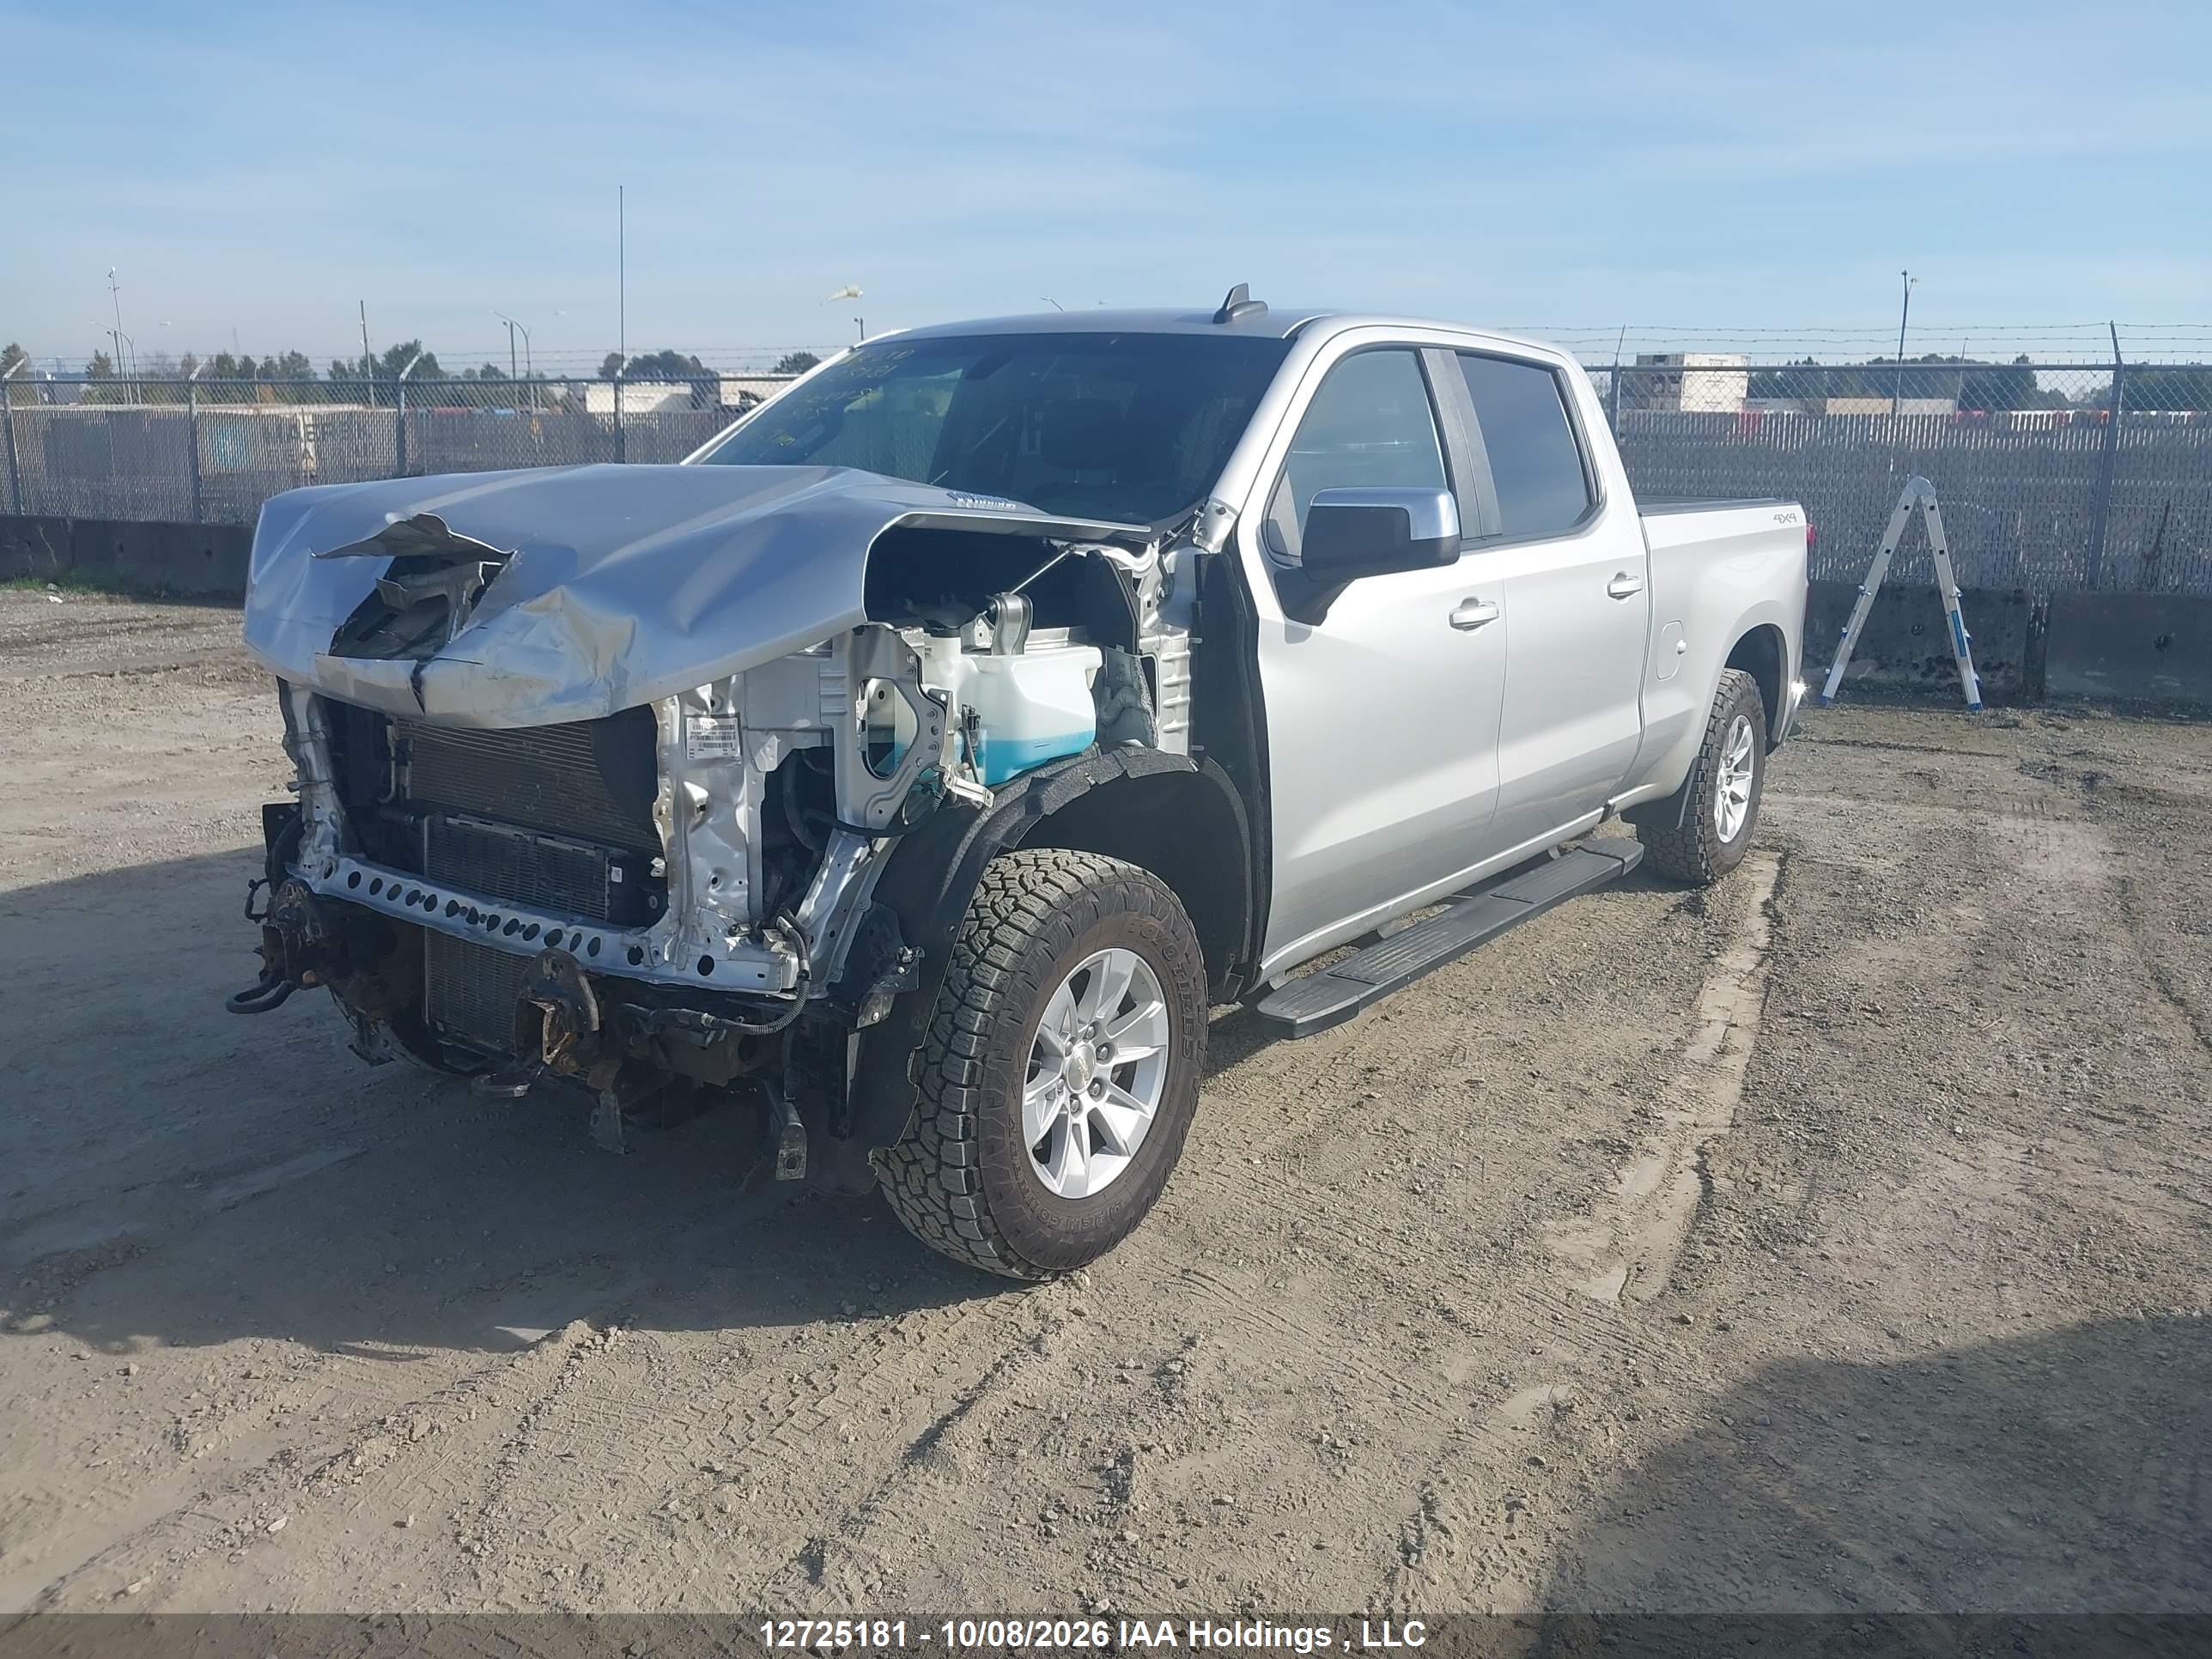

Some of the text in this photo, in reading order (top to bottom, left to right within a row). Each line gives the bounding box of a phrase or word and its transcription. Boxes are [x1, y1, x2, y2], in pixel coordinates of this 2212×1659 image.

[1773, 513, 1797, 524] 4X4
[1126, 919, 1196, 1061] TOYO TIRES
